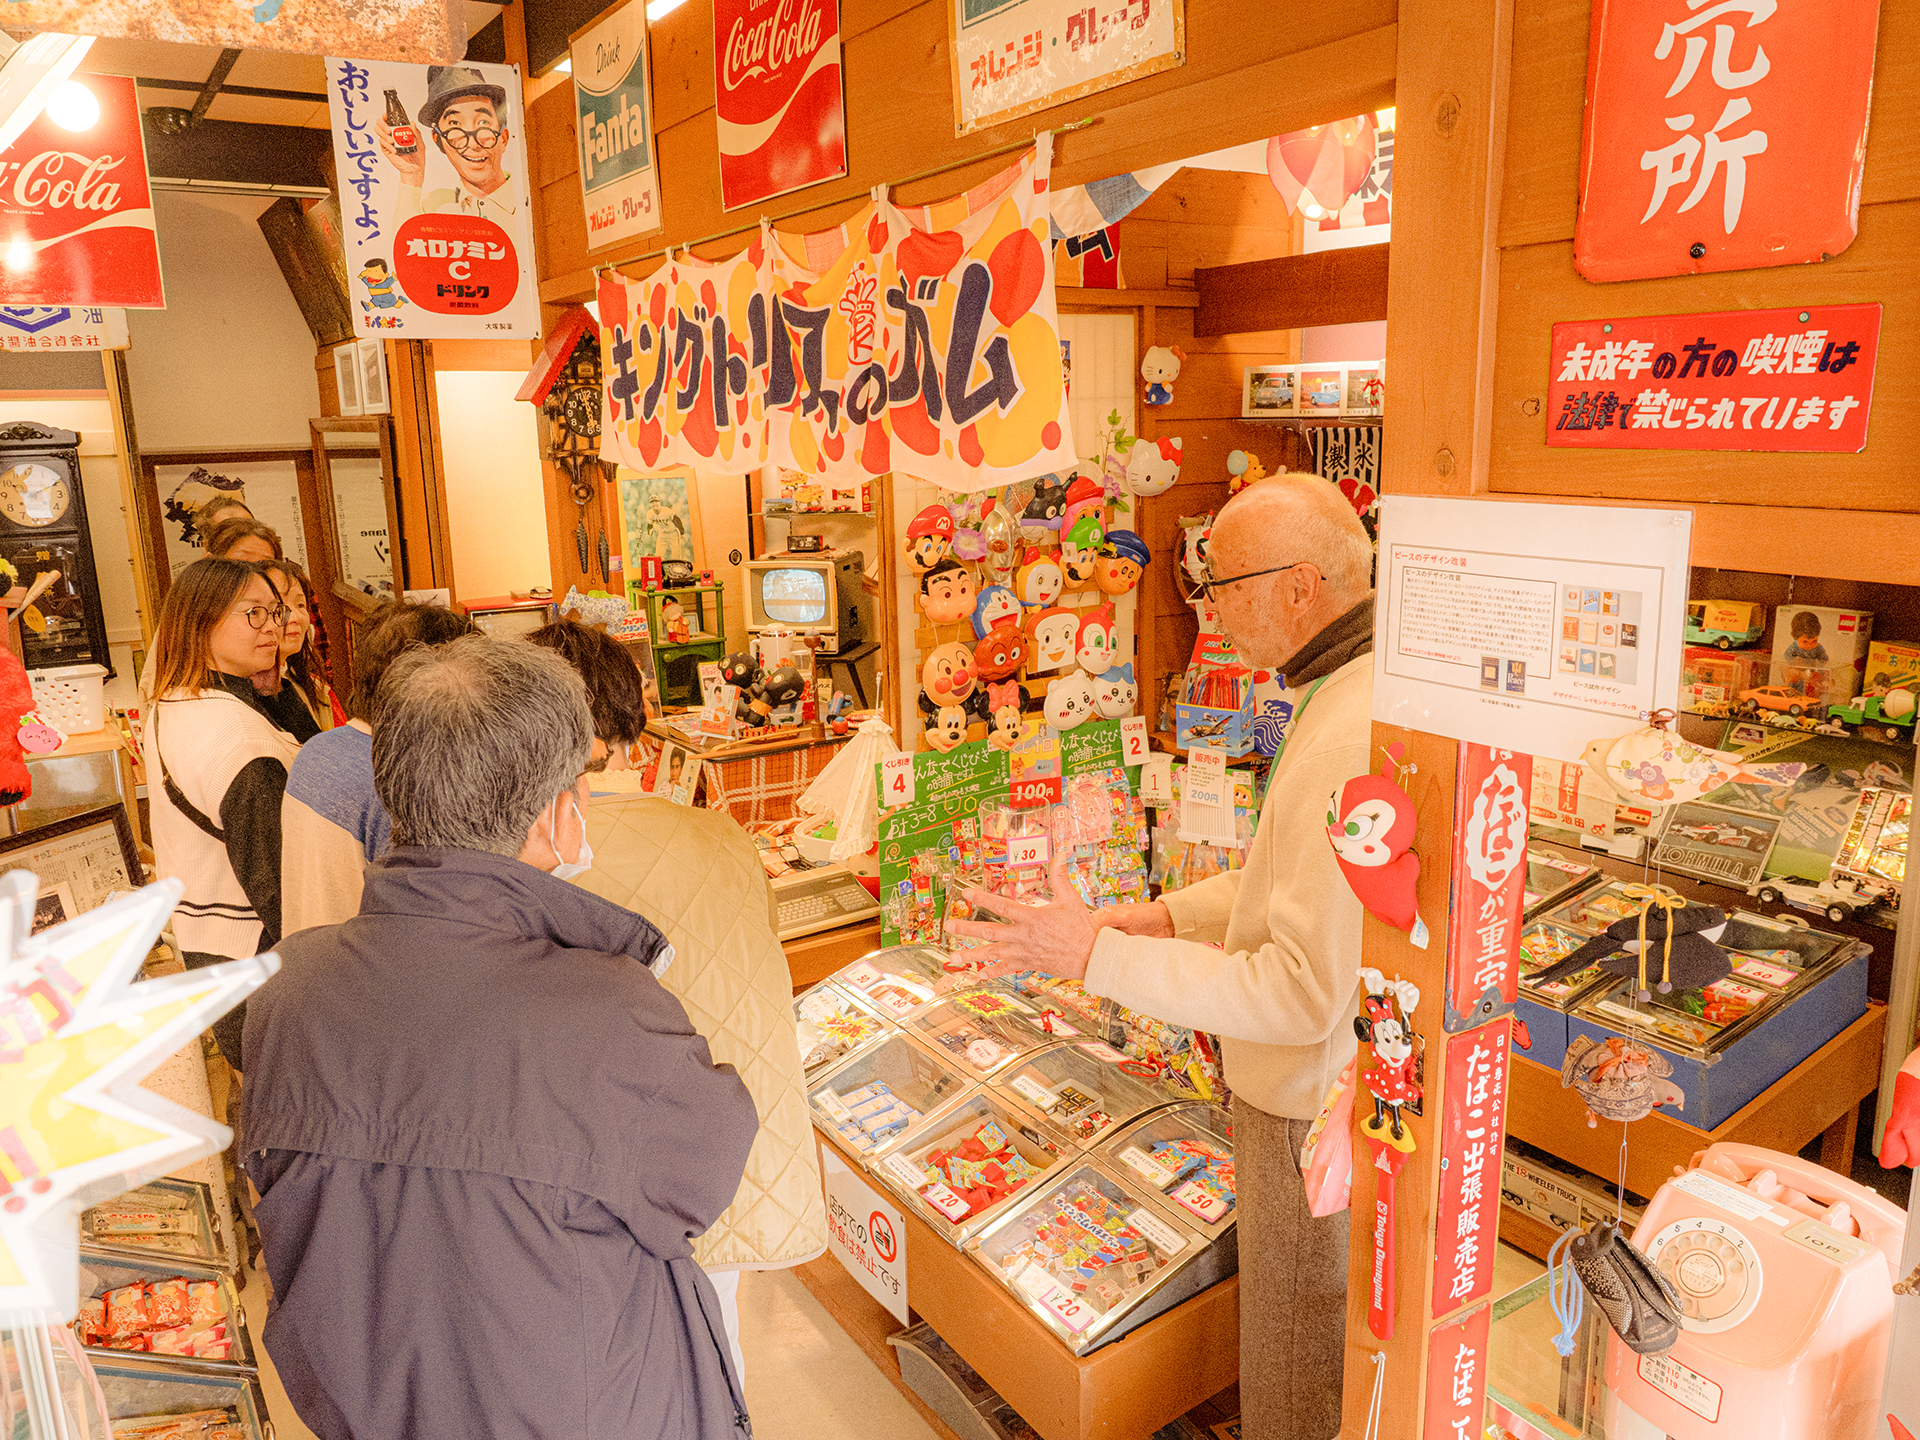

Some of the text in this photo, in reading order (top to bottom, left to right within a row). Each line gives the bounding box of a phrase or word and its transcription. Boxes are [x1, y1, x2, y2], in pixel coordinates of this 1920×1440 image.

[724, 0, 822, 91] Coca-Cola
[596, 37, 621, 76] Drink
[583, 94, 643, 181] Fanta
[406, 238, 506, 261] オロナミン
[448, 261, 471, 281] C
[437, 284, 490, 299] ドリンク
[1557, 330, 1860, 383] 未成年の方の喫煙は
[1555, 387, 1860, 431] 法律で禁じられています
[1394, 551, 1467, 568] ピースのデザイン改装
[1123, 722, 1143, 732] くじ引き
[1129, 737, 1141, 756] 2
[885, 758, 910, 769] くじ引き
[1194, 752, 1220, 765] 販売中
[892, 773, 906, 794] 4
[1016, 783, 1053, 801] 100円
[1191, 789, 1219, 804] 200円
[1561, 814, 1585, 828] 池田
[1661, 844, 1742, 877] FORMULA
[1449, 1045, 1491, 1299] たばこ出張販売店
[1504, 1161, 1515, 1172] THE
[1556, 1187, 1578, 1204] TRUCK
[829, 1193, 868, 1244] 店内での
[1696, 1221, 1703, 1229] 4
[1674, 1225, 1681, 1233] 5
[1718, 1225, 1725, 1234] 3
[1657, 1238, 1664, 1246] 6
[1737, 1240, 1744, 1249] 2
[829, 1213, 901, 1295] 飲食は禁止です
[1373, 1214, 1387, 1311] Tokyo Disneyland
[1749, 1260, 1754, 1268] 1
[1667, 1366, 1680, 1380] 110
[1665, 1376, 1679, 1390] 119
